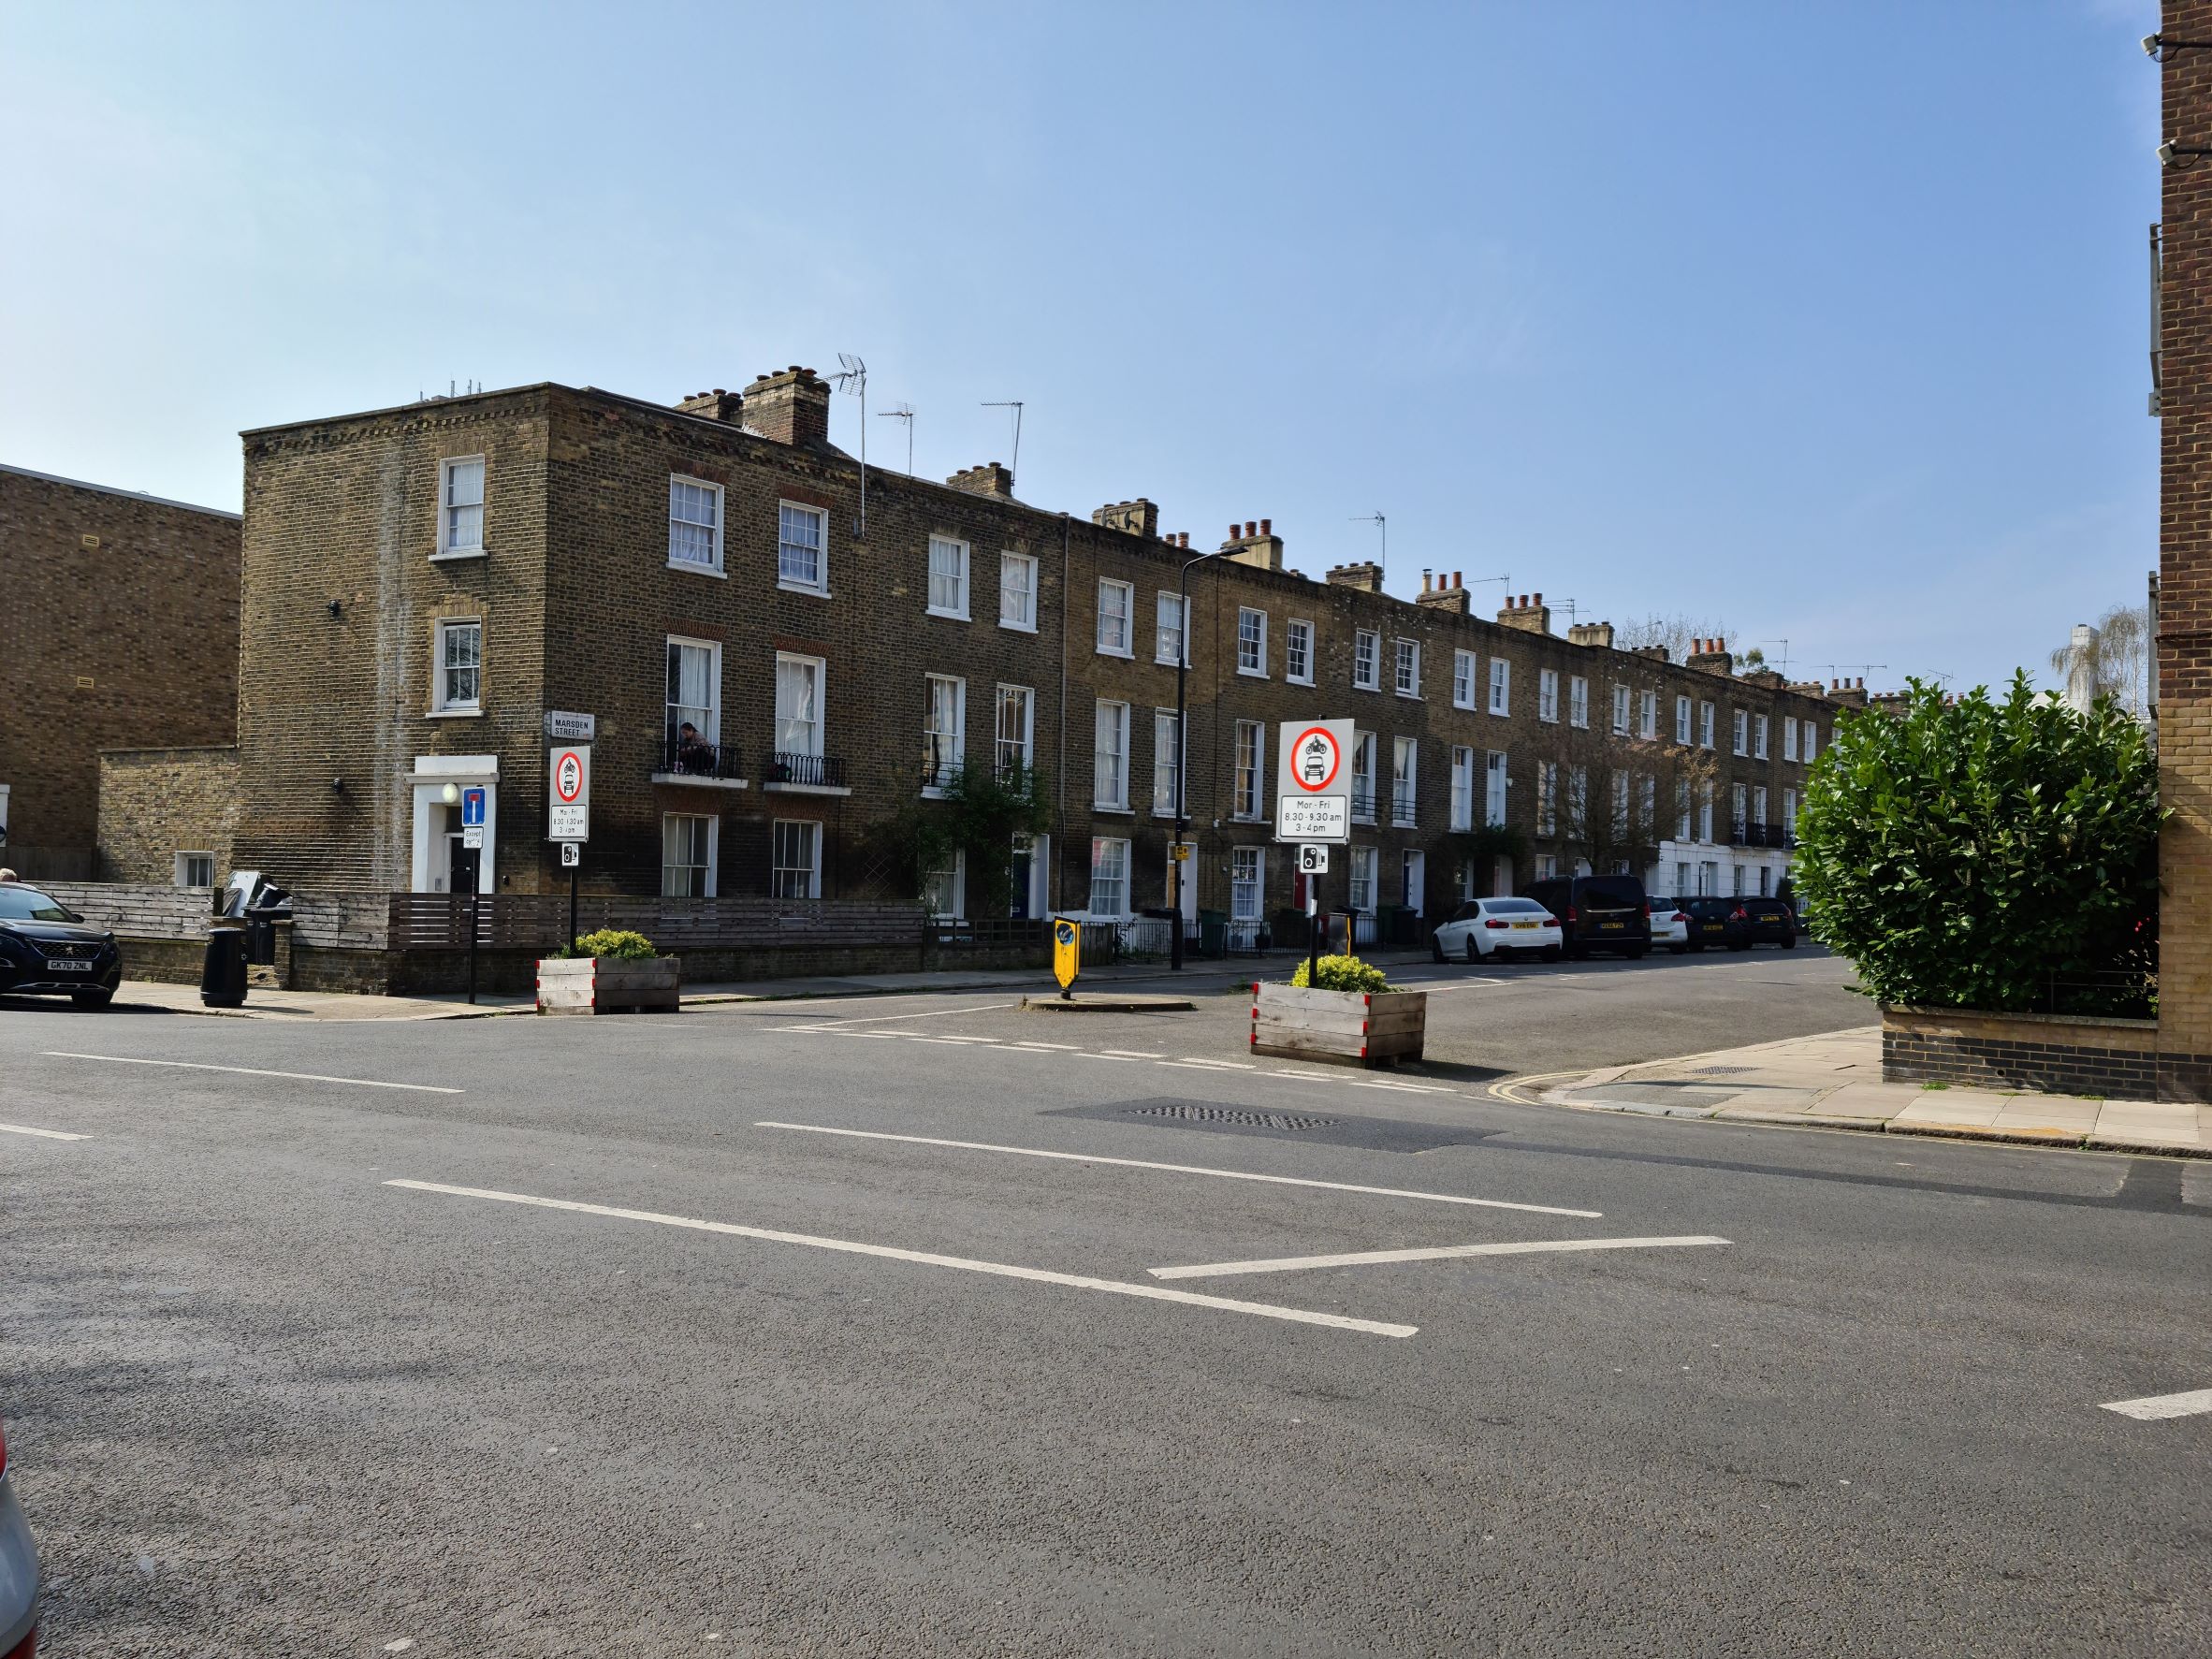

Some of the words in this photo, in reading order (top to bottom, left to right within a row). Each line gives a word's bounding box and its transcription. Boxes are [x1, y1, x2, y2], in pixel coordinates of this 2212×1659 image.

[555, 720, 588, 729] MARSDEN
[1319, 800, 1330, 809] Fri
[1285, 813, 1303, 821] 8.30
[1310, 813, 1328, 821] 9.30
